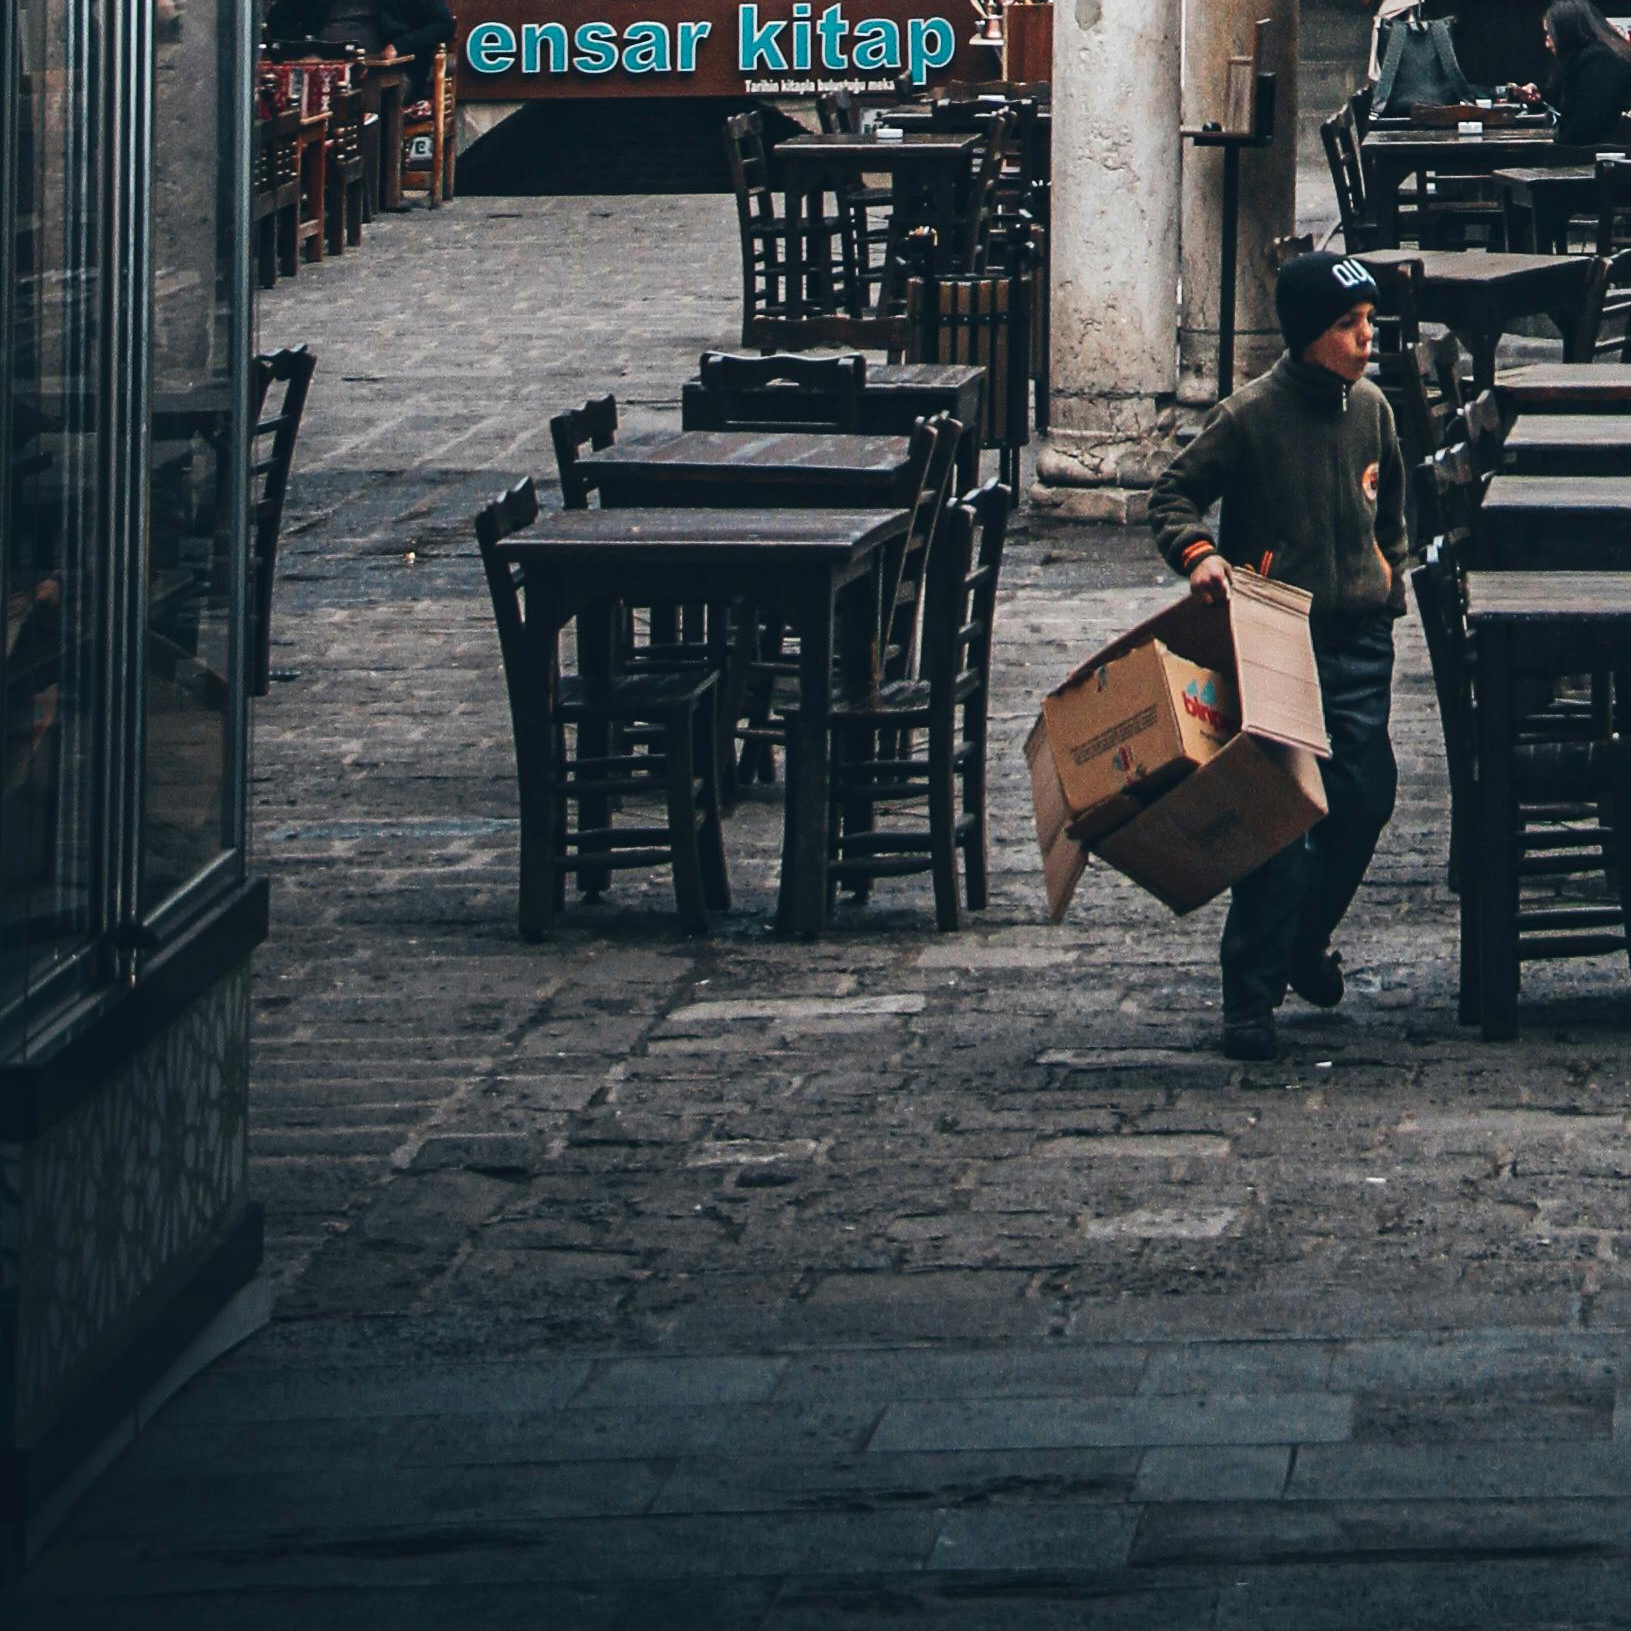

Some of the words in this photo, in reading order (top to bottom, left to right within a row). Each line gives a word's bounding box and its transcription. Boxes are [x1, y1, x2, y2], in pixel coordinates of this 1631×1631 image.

[466, 20, 712, 74] ensar
[737, 1, 956, 86] kitap
[745, 79, 779, 93] Tarihin
